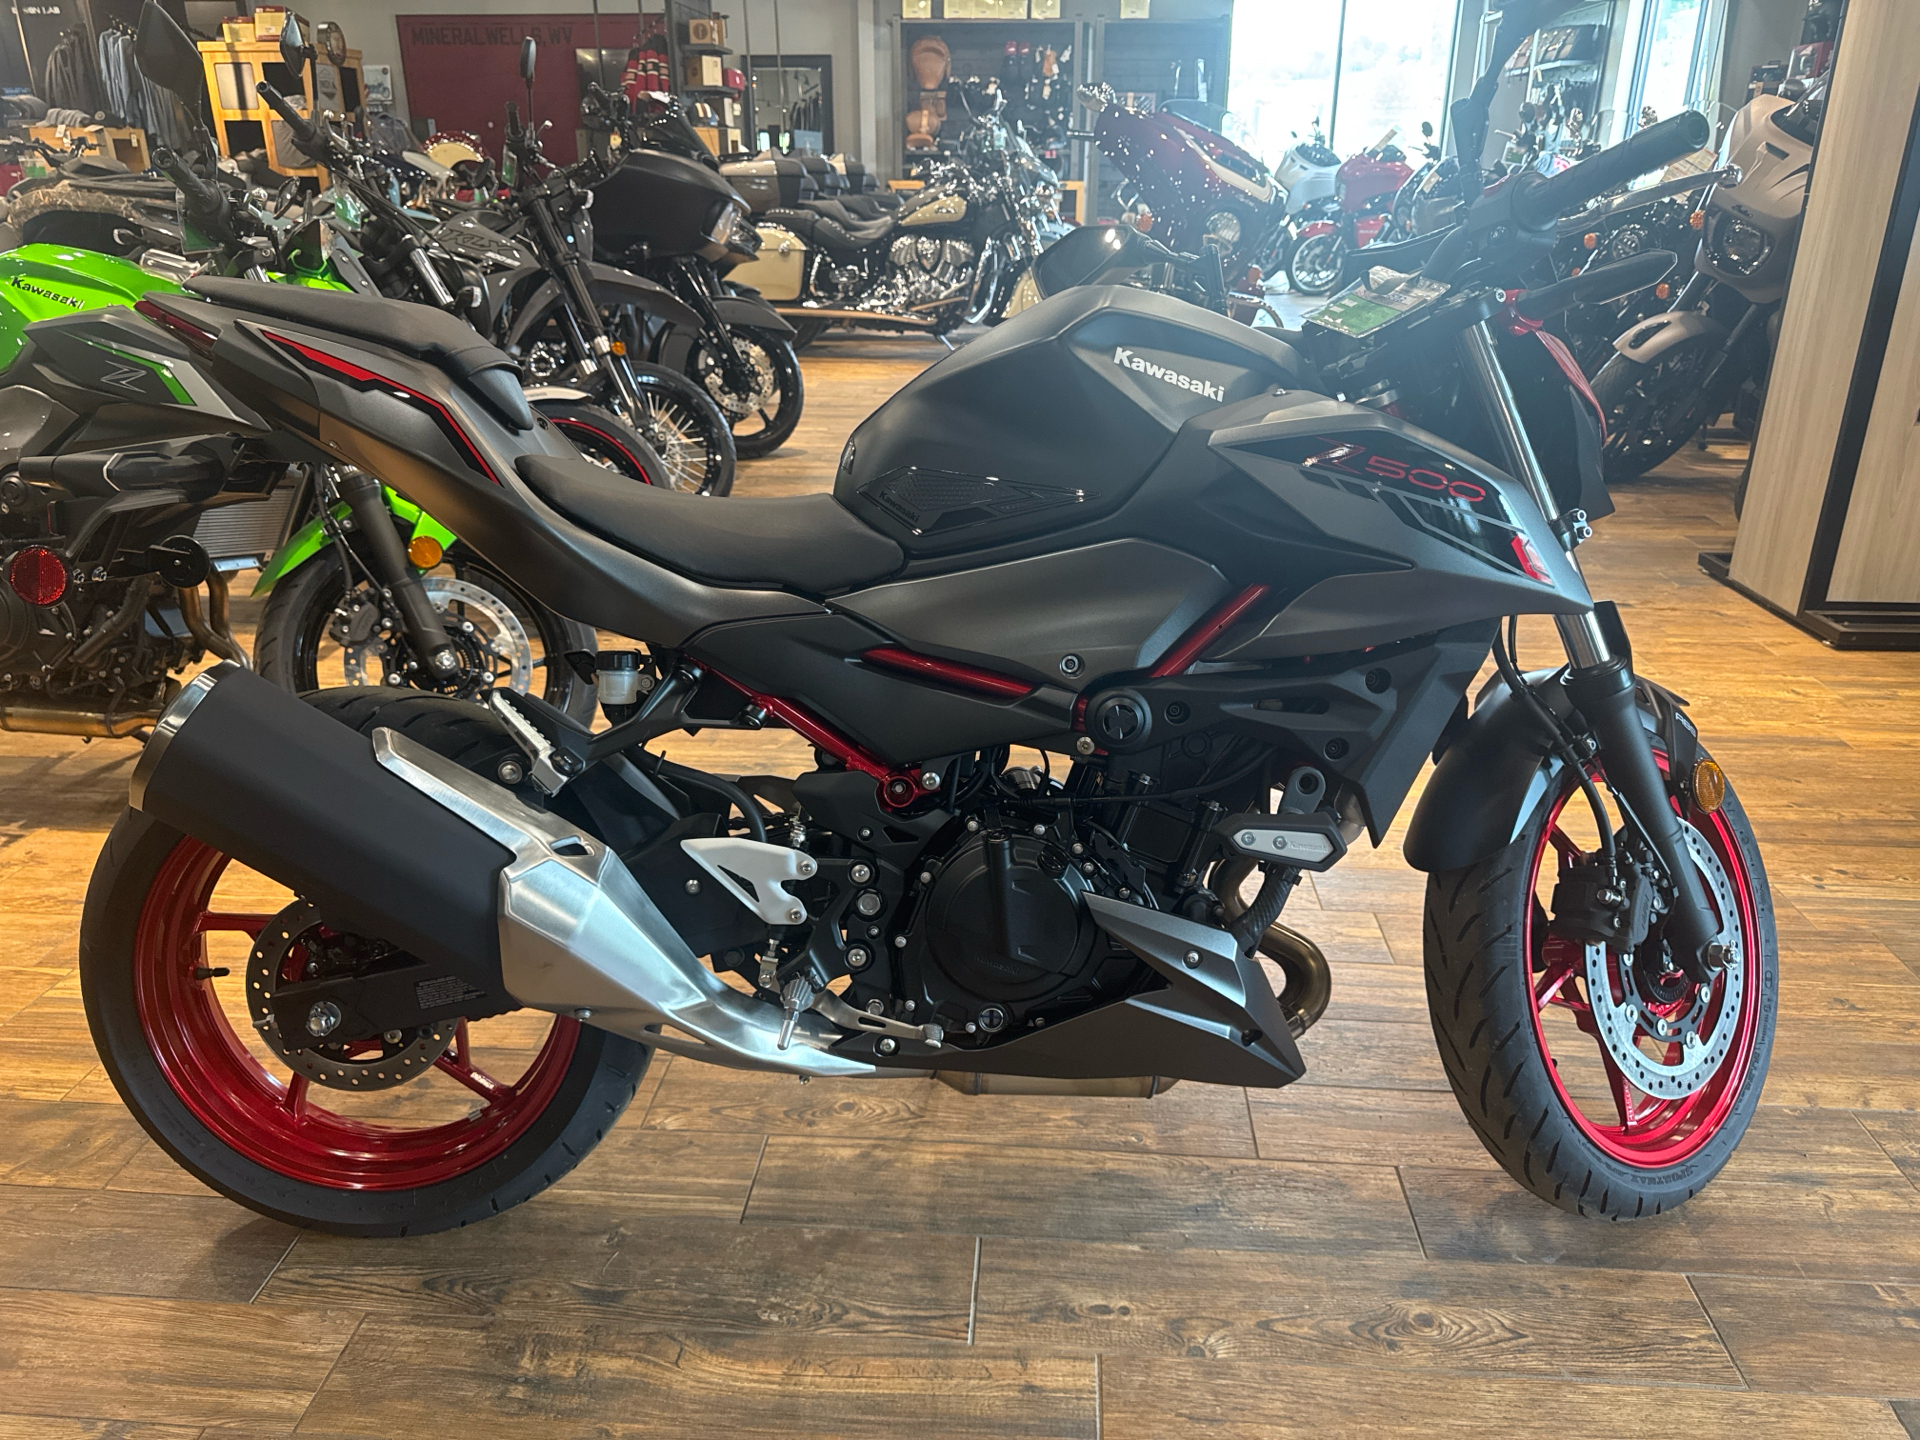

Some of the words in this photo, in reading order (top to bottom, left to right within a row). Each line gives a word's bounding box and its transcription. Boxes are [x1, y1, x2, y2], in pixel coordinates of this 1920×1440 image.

[548, 26, 573, 45] WV
[11, 276, 86, 310] Kawasaki
[1113, 346, 1225, 403] Kawasaki
[879, 490, 920, 523] Kawasaki
